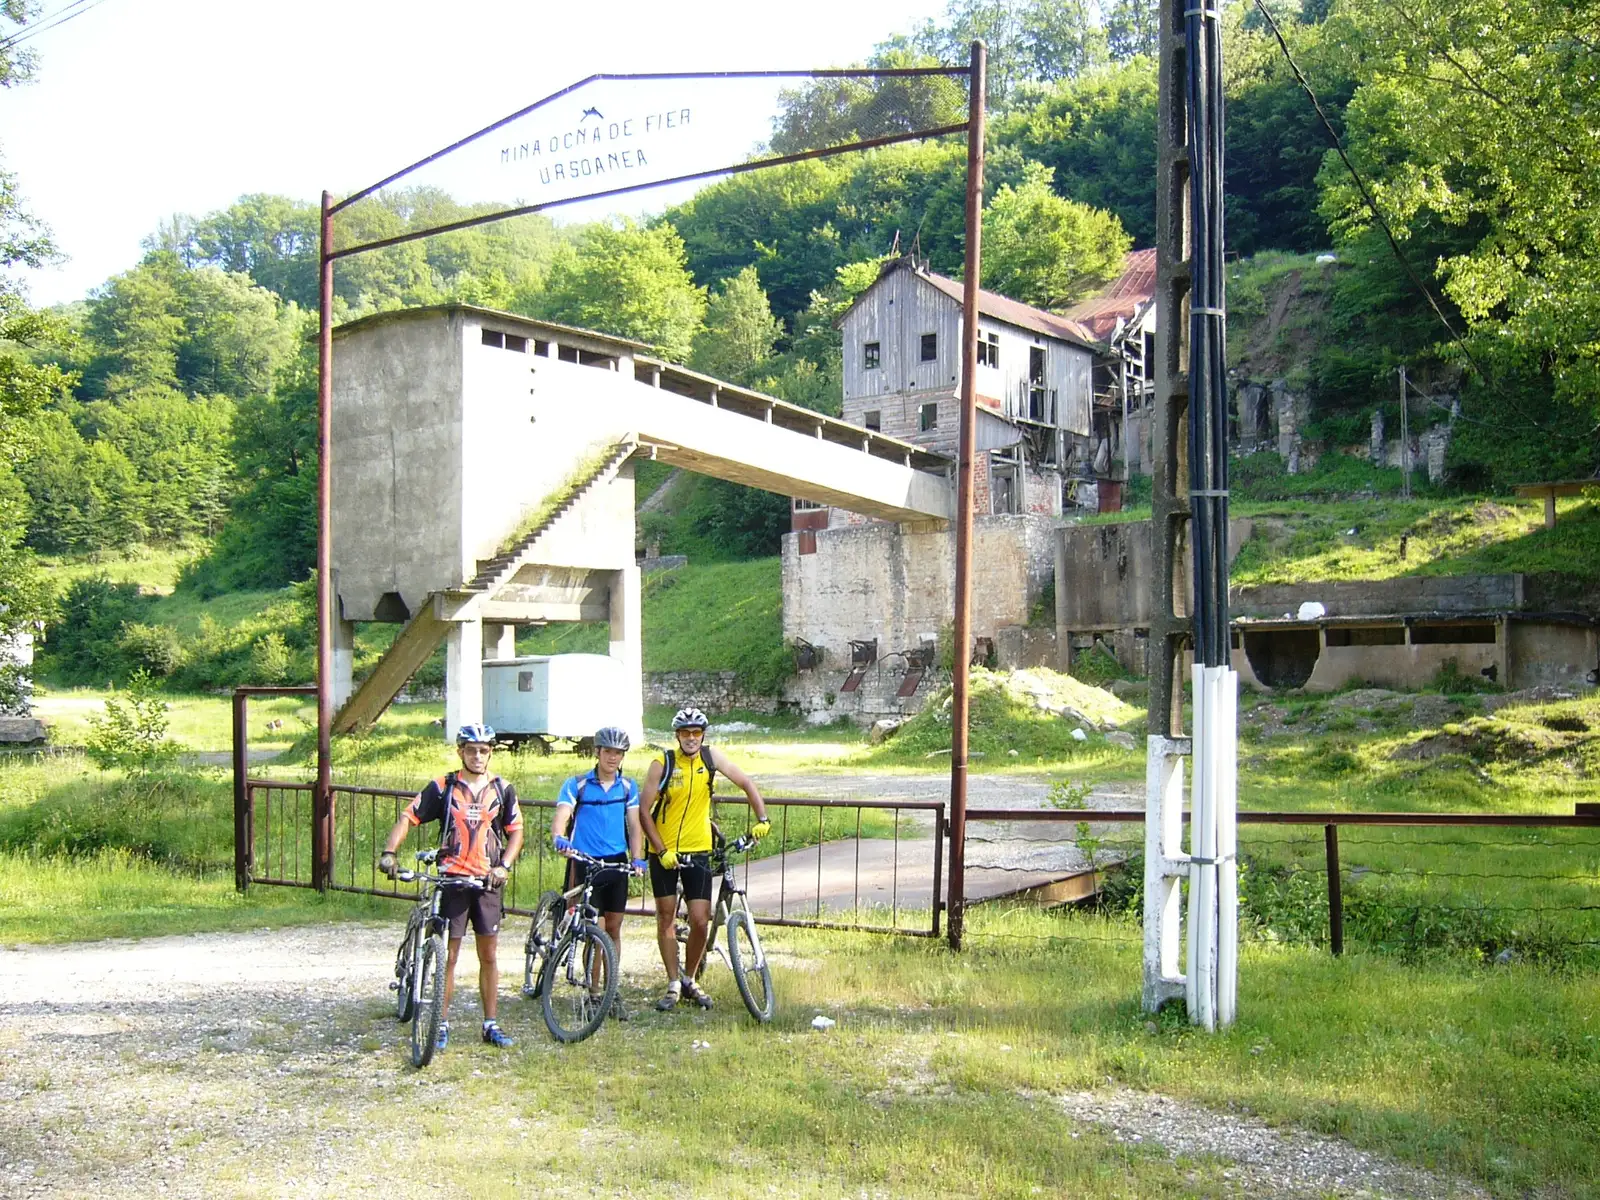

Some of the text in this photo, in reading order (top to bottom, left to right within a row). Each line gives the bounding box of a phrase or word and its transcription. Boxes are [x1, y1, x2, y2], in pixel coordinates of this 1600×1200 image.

[500, 108, 690, 163] MINA OCNA DE FIER
[539, 149, 648, 184] URSOANEA
